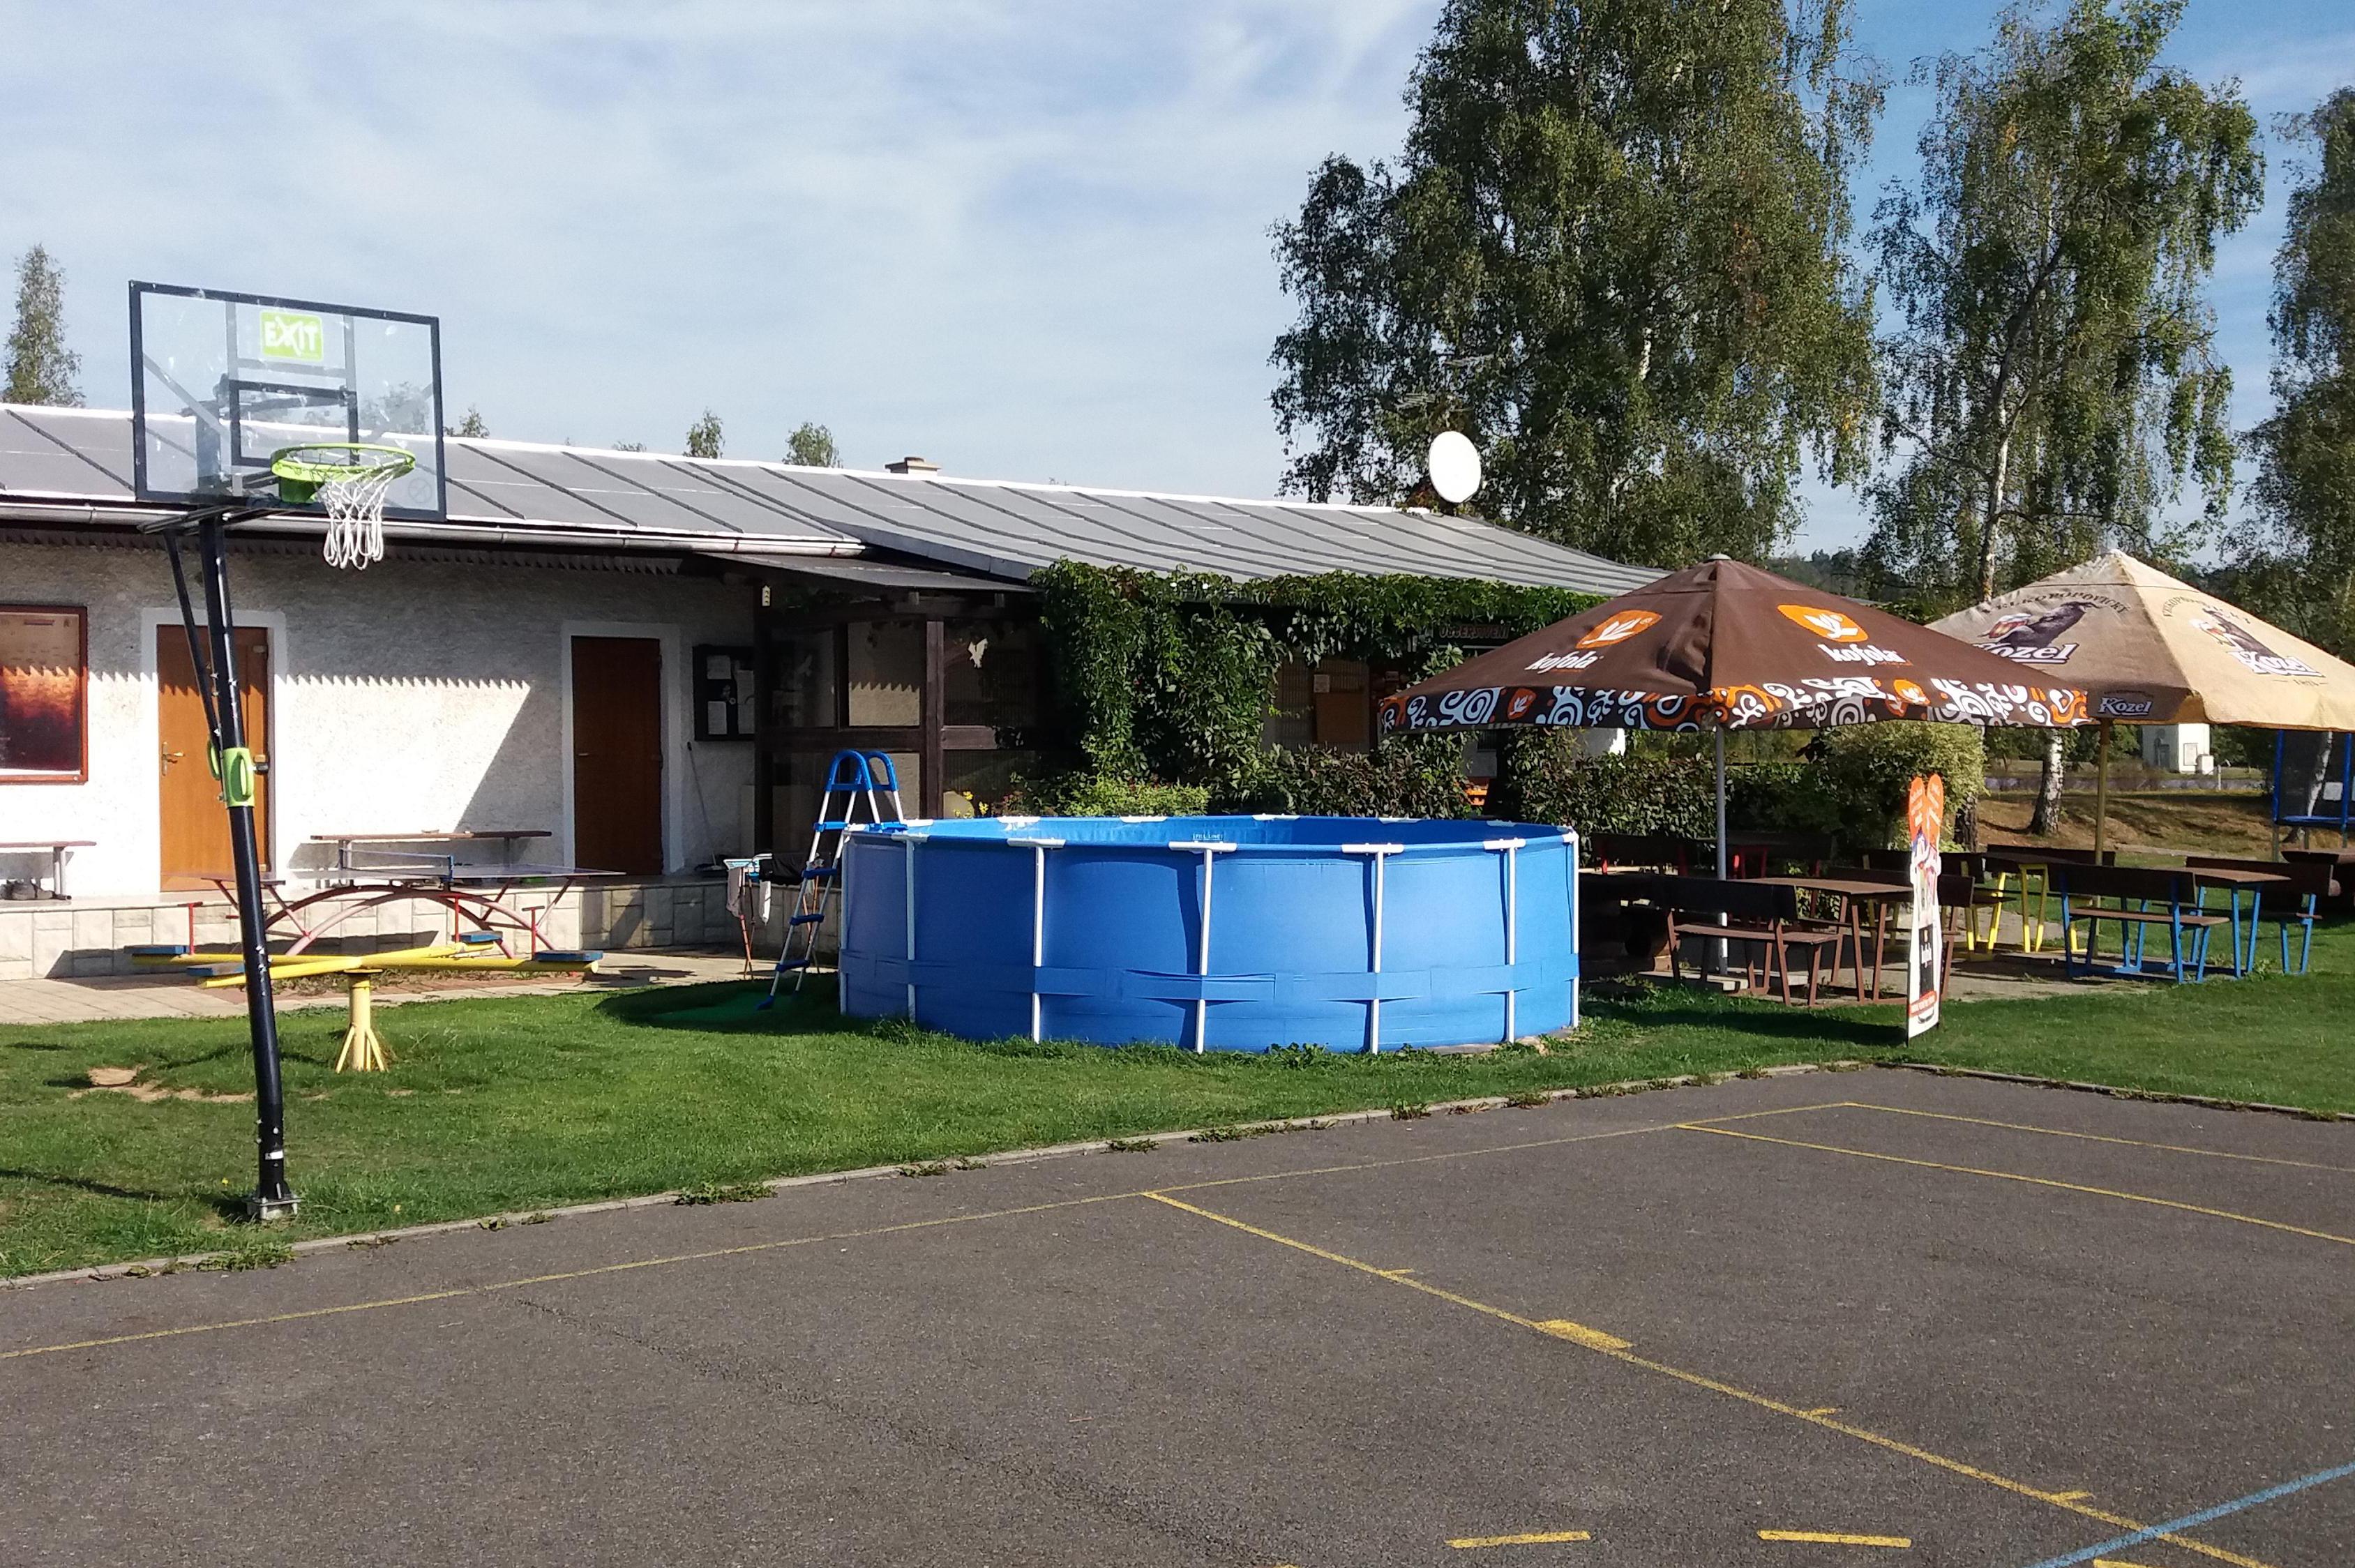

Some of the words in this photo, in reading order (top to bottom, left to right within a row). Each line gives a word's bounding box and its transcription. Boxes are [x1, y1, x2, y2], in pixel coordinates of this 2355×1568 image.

[264, 316, 318, 357] EXIT
[1524, 650, 1598, 674] kofola
[1817, 643, 1907, 666] kofola
[2227, 651, 2326, 678] Kozel
[2098, 698, 2153, 716] Kozel
